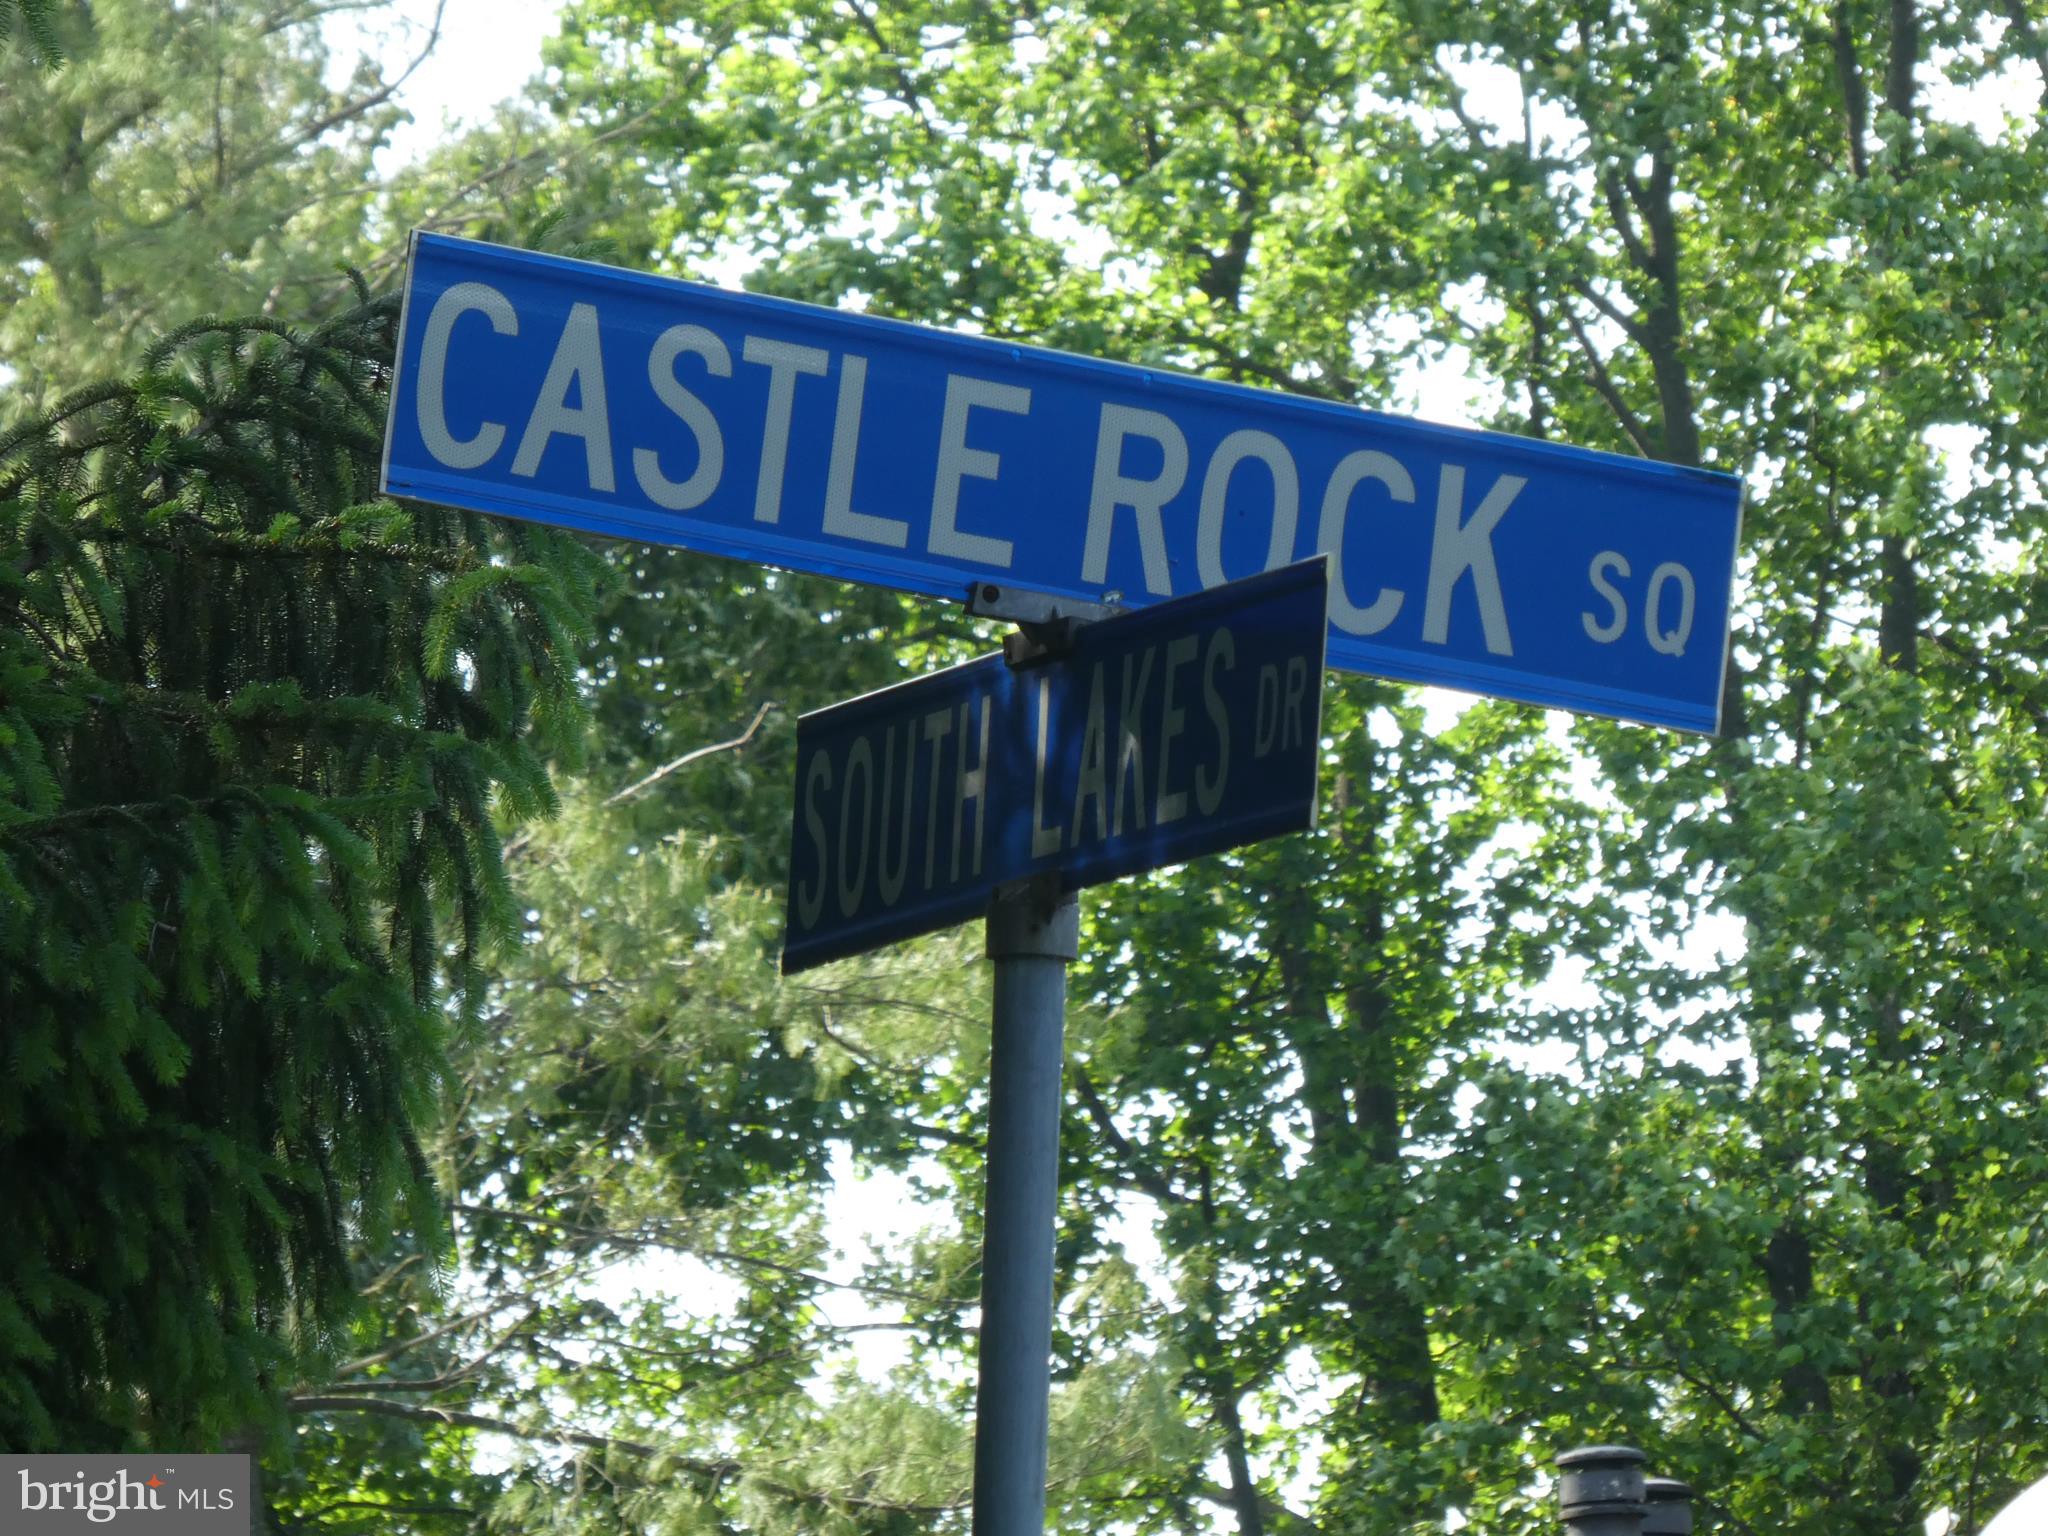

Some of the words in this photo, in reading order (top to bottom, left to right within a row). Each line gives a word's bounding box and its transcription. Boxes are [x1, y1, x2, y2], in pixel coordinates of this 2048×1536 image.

[416, 282, 1031, 568] CASTLE
[1081, 402, 1528, 656] ROCK
[1582, 551, 1695, 657] SQ
[799, 695, 991, 930] SOUTH
[1031, 627, 1236, 859] LAKES
[1254, 656, 1307, 760] DR
